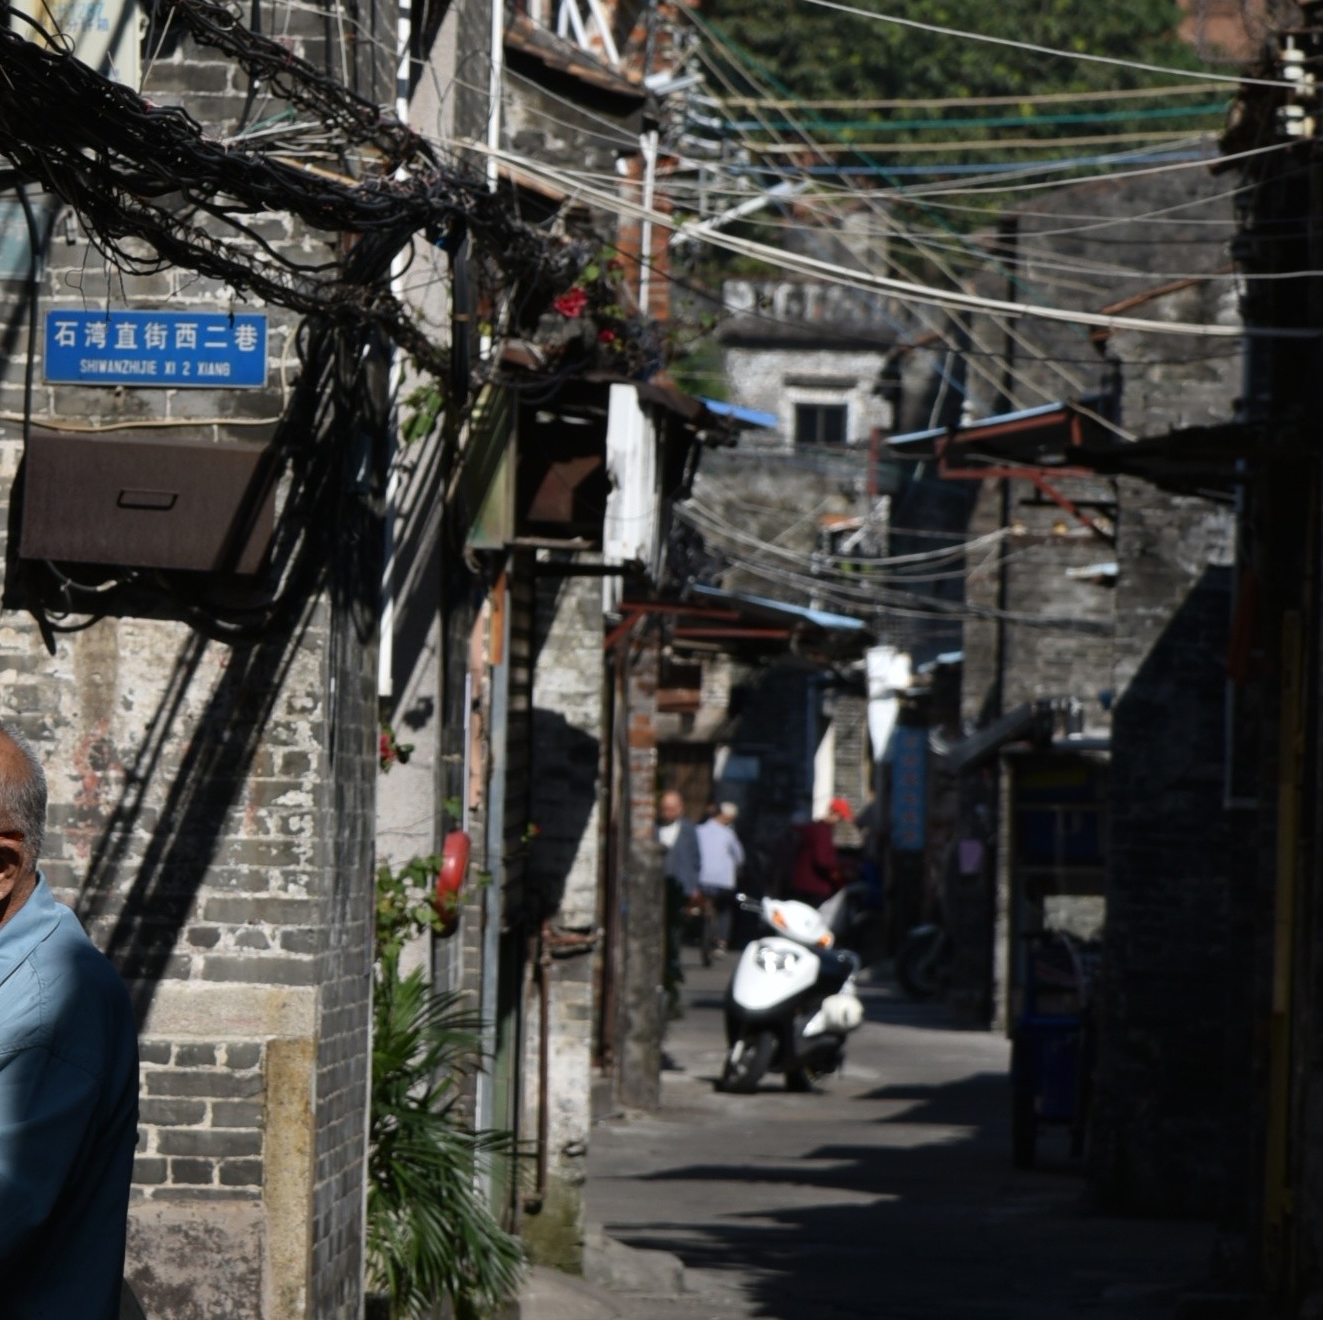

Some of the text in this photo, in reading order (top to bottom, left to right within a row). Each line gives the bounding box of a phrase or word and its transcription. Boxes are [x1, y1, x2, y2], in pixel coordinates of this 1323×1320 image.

[54, 321, 258, 352] 石湾直街西二巷
[80, 359, 231, 377] SHIWANZHIJIE XI 2 XIANG
